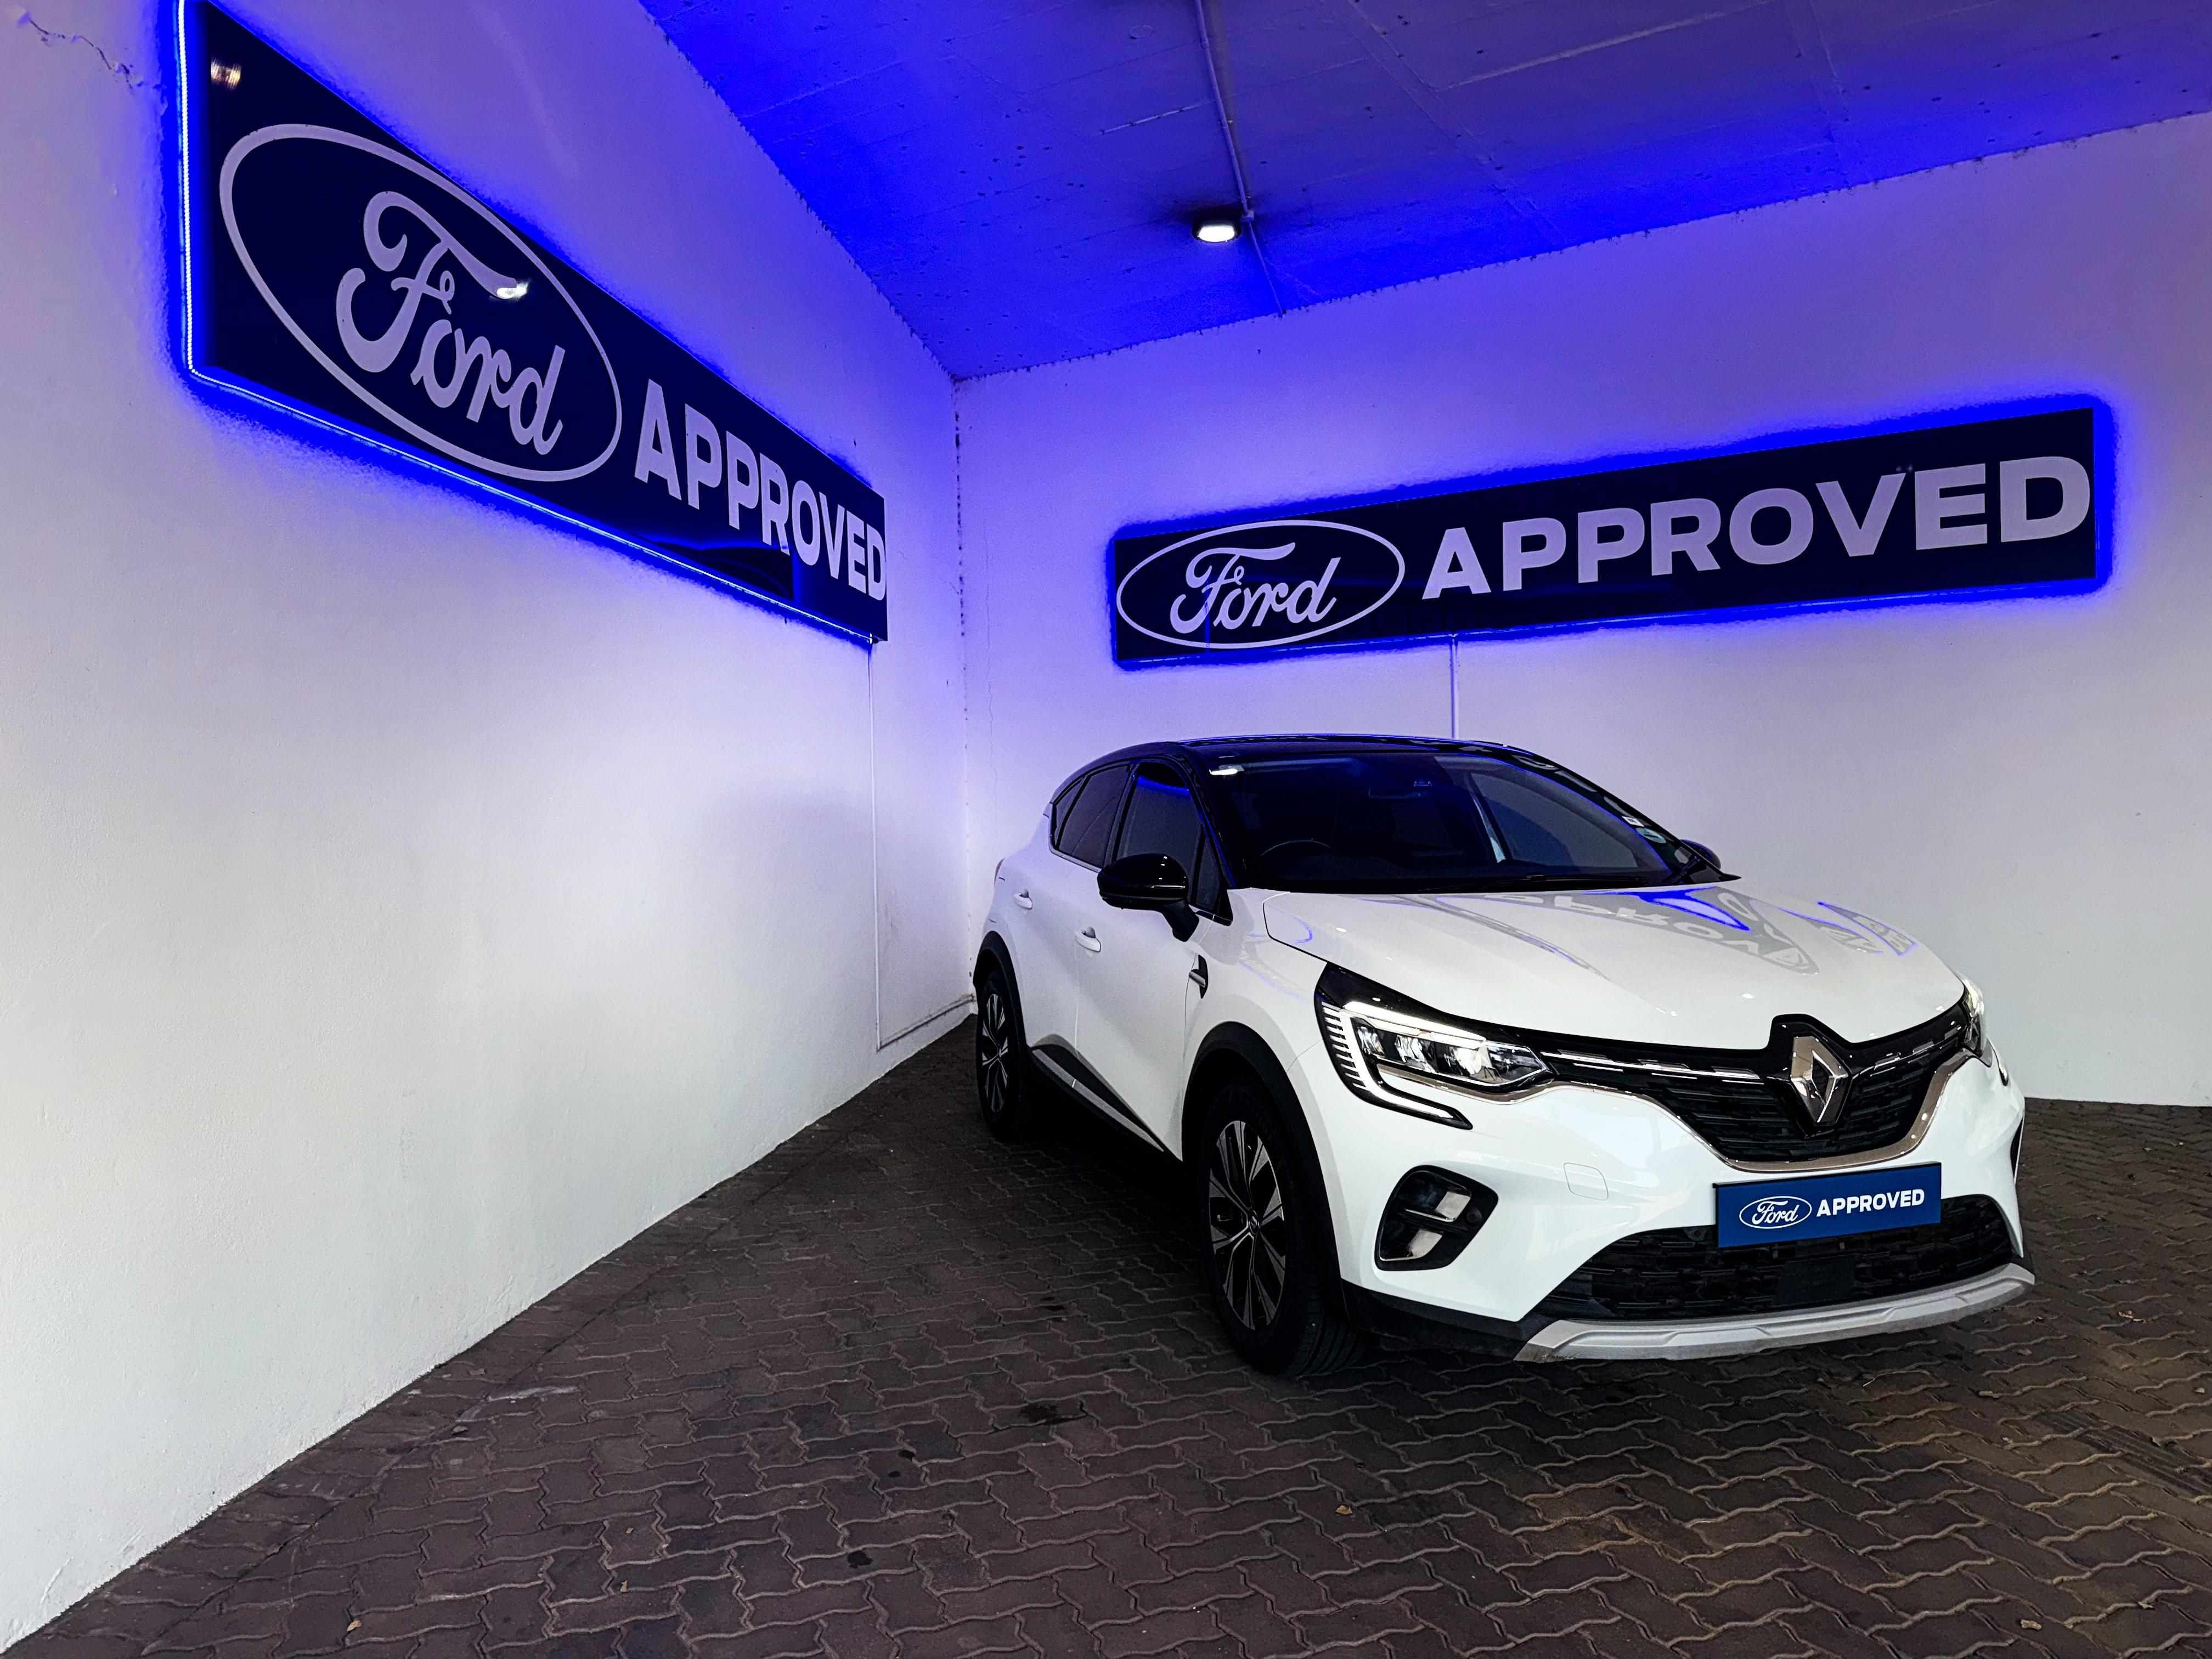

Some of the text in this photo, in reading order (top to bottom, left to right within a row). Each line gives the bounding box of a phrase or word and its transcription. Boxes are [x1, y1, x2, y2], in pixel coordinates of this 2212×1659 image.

[336, 191, 887, 601] Ford APPROVED
[1170, 456, 2090, 634] Ford APPROVED
[1752, 1189, 1925, 1225] Ford APPROVED
